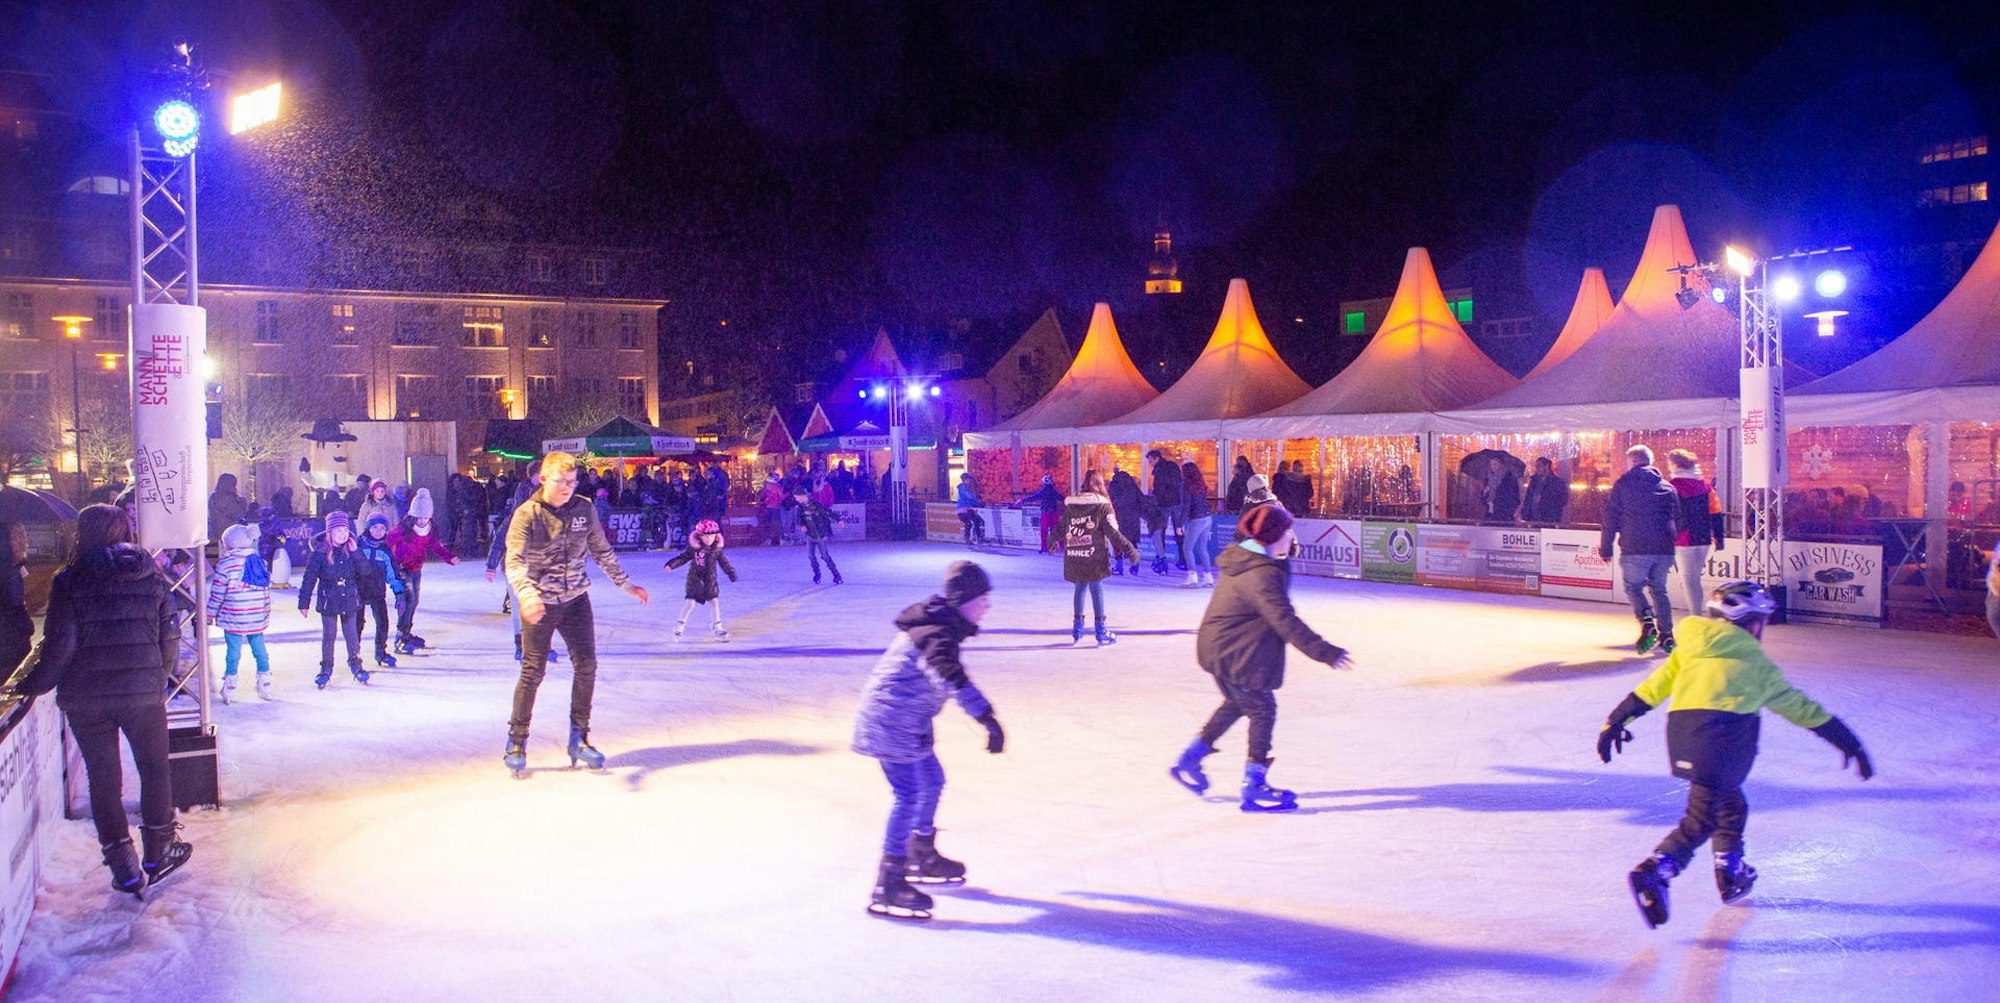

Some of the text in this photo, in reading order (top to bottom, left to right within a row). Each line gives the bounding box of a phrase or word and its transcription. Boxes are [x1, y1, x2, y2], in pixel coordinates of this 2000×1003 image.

[152, 335, 168, 405] SCHETTE
[1502, 534, 1535, 546] BOHLE
[1298, 544, 1353, 563] RTHAUS
[1789, 547, 1875, 576] BUSINESS
[1806, 585, 1826, 600] CAR
[1828, 587, 1856, 604] WASH
